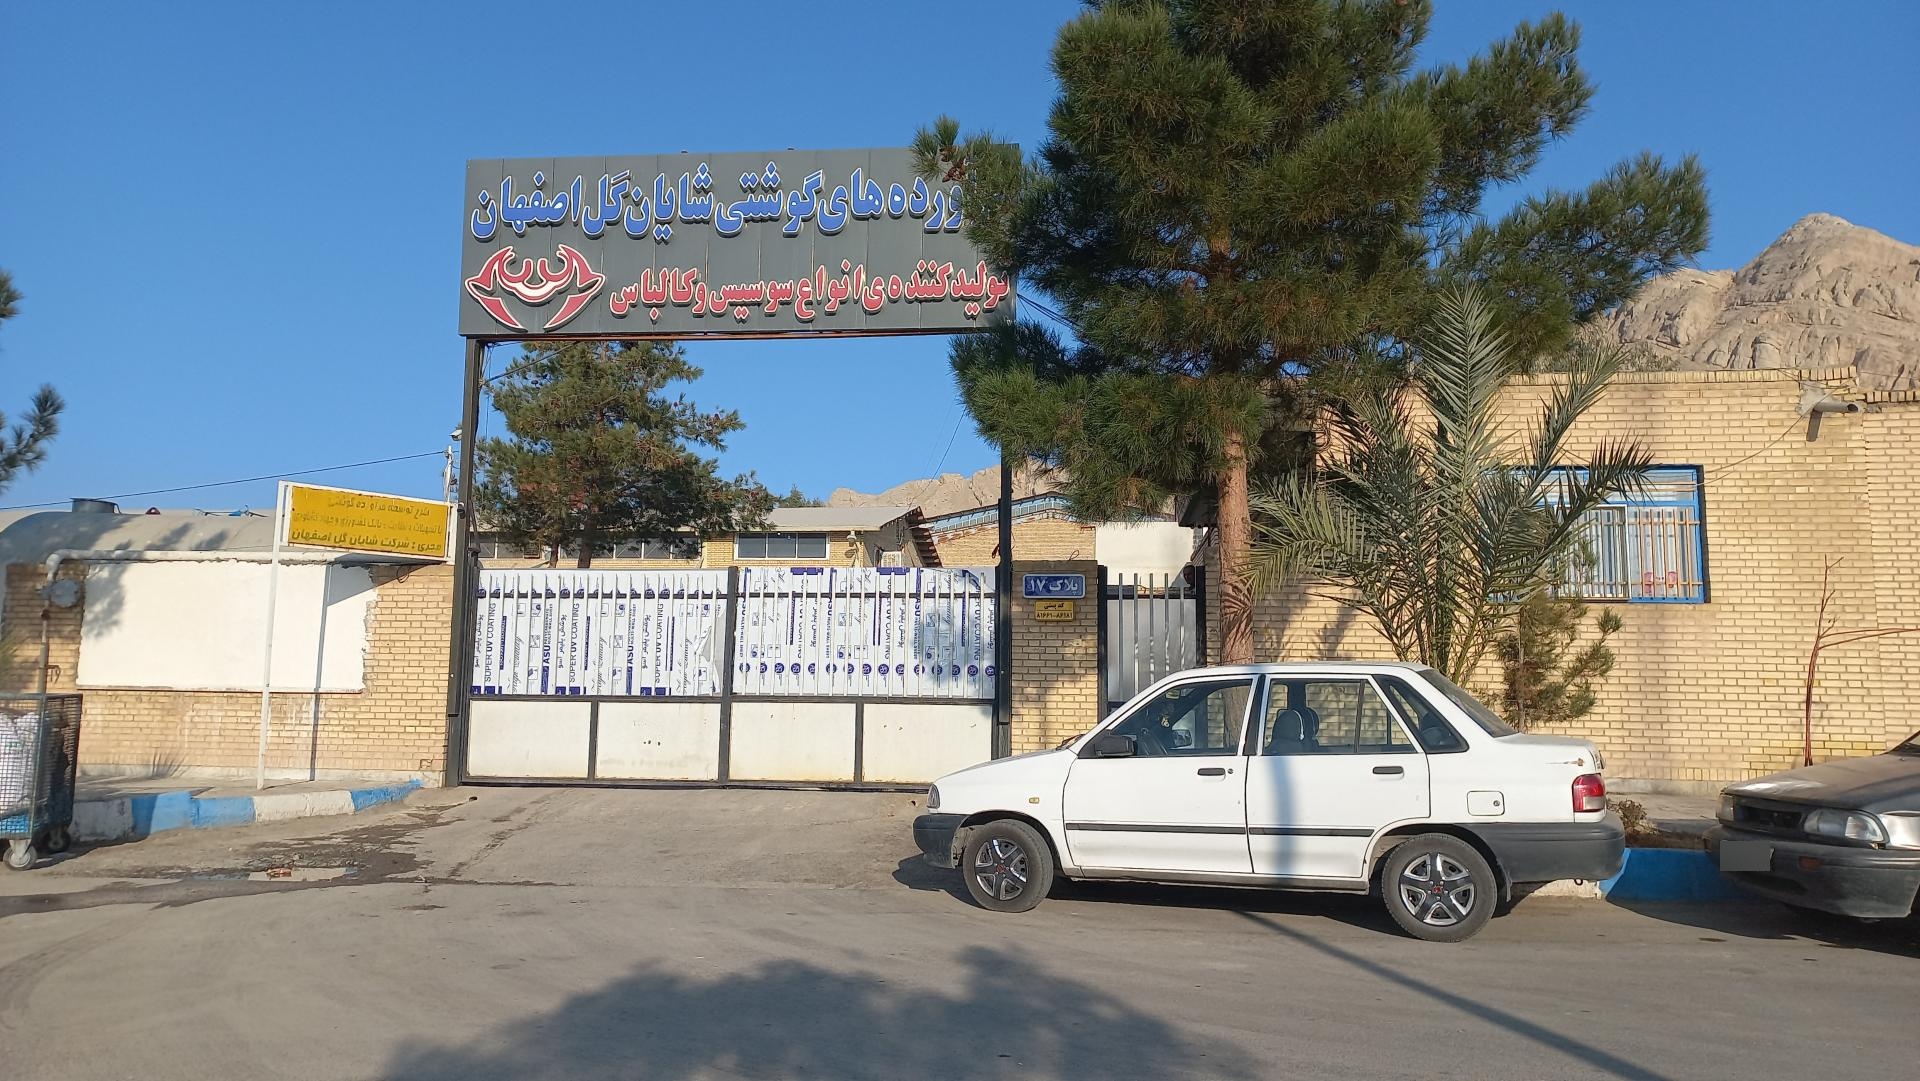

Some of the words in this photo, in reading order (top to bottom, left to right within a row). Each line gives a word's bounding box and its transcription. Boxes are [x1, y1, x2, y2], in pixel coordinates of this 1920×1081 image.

[470, 171, 582, 240] اصفهان
[582, 169, 632, 236] گل
[624, 163, 714, 242] شایان
[715, 161, 823, 236] گوشتی
[817, 169, 881, 232] های
[708, 278, 795, 320] سوسیس
[795, 259, 865, 321] انواع
[1031, 579, 1045, 592] ۱۷
[1049, 579, 1077, 595] پلاک
[487, 603, 496, 639] COATING
[572, 603, 580, 639] COATING
[486, 641, 493, 652] UV
[543, 646, 551, 664] ASU
[571, 641, 577, 652] UV
[485, 655, 493, 682] SUPER
